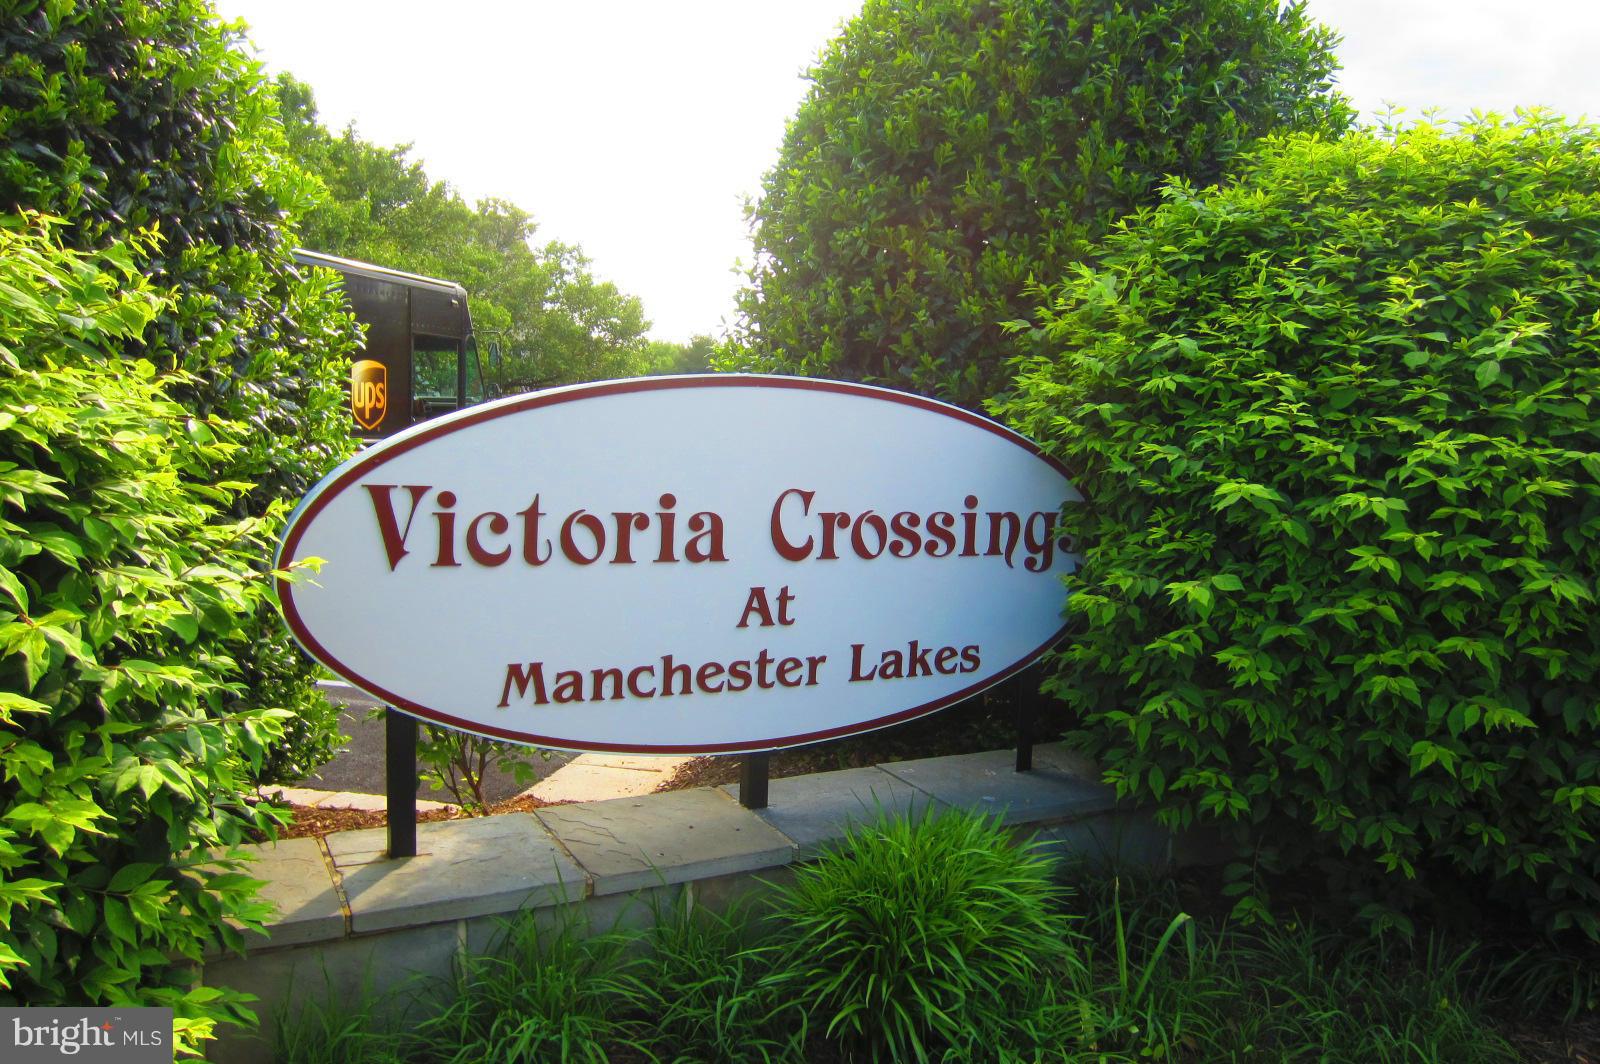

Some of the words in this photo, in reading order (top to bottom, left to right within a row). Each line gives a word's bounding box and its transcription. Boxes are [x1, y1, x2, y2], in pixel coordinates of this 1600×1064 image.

[354, 381, 386, 420] ups
[361, 484, 730, 572] Victoria
[736, 585, 796, 628] At
[496, 648, 827, 708] Manchester
[848, 640, 981, 682] Lakes
